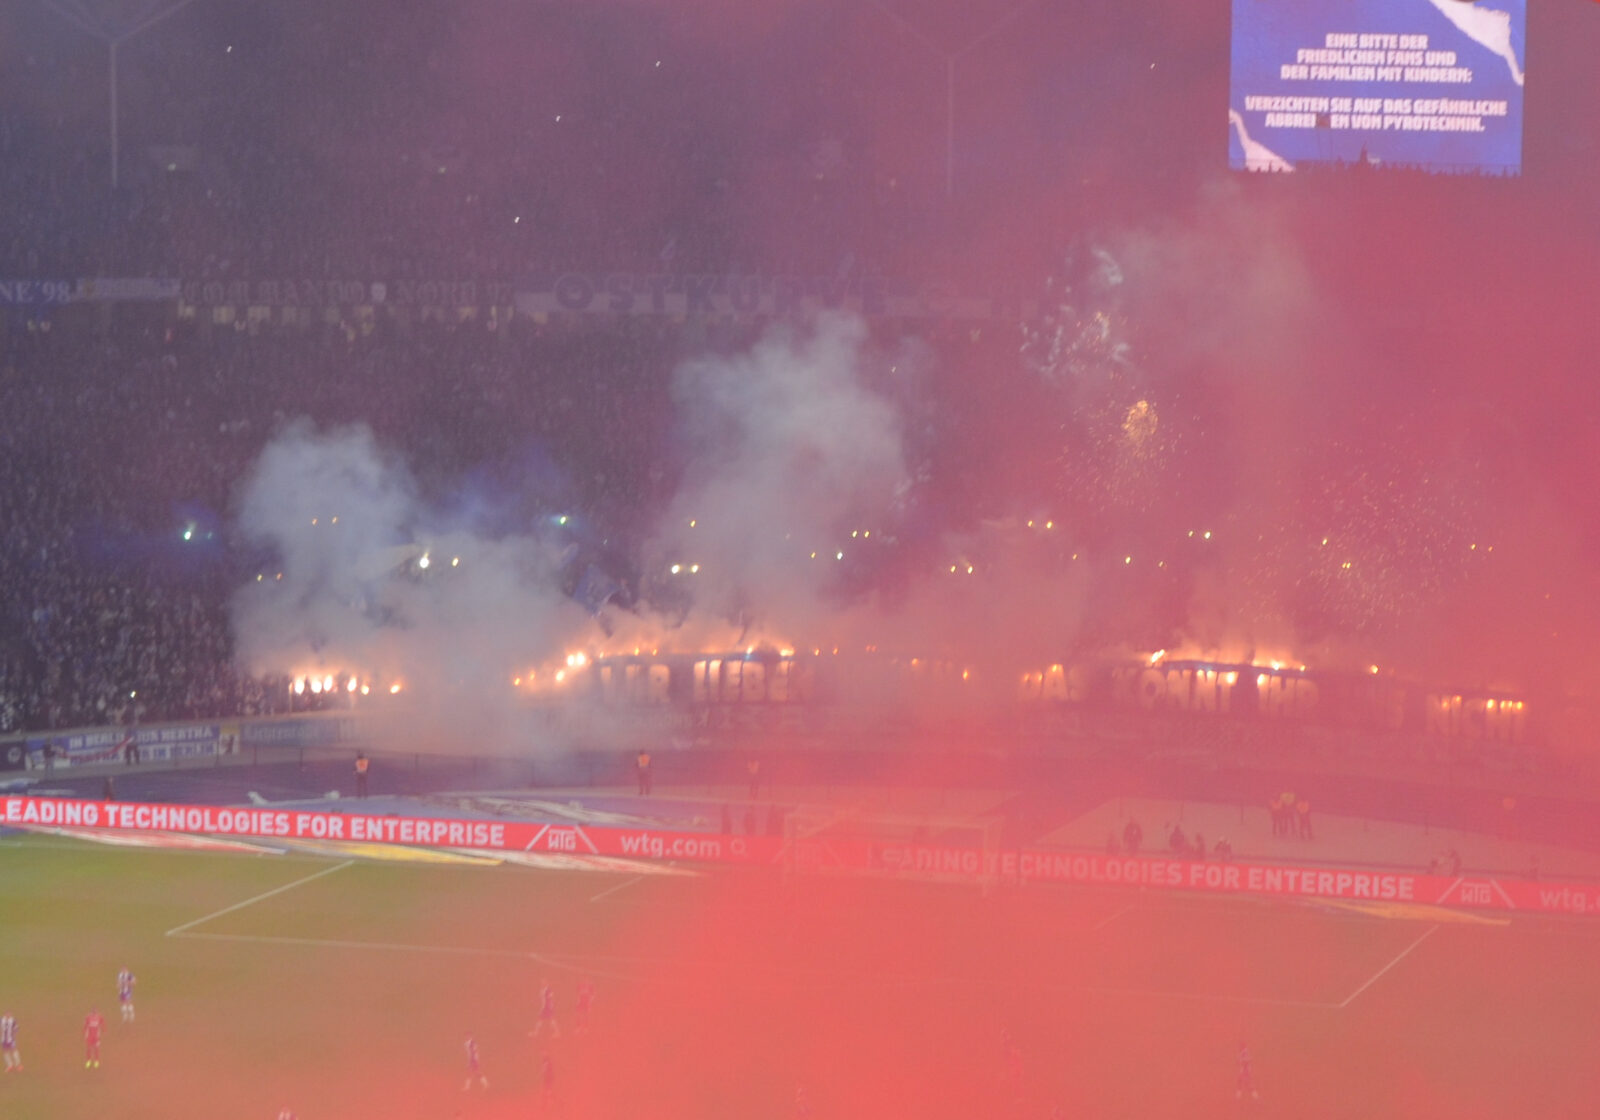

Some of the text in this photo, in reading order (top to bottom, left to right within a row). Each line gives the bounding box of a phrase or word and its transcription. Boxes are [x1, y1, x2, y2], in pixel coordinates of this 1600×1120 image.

[1326, 34, 1428, 49] EINE BITTE DER
[1297, 50, 1457, 67] FRIEDLICHEN FANS UND
[1281, 65, 1472, 83] DER FAMILIEN MIT KINDERN:
[1245, 96, 1507, 116] VERZICHTEN SIE AUF DAS GEFÄHRLICHE
[1351, 114, 1382, 129] VON
[1383, 115, 1485, 132] PYROTECHNIK.
[0, 800, 505, 847] EADING TECHNOLOGIES FOR ENTERPRISE
[547, 829, 576, 850] WTG
[620, 832, 721, 857] wtg.com
[985, 851, 1182, 886] TECHNOLOGIES
[1190, 863, 1240, 889] FOR
[1247, 866, 1414, 900] ENTERPRISE
[1461, 882, 1491, 904] WTG
